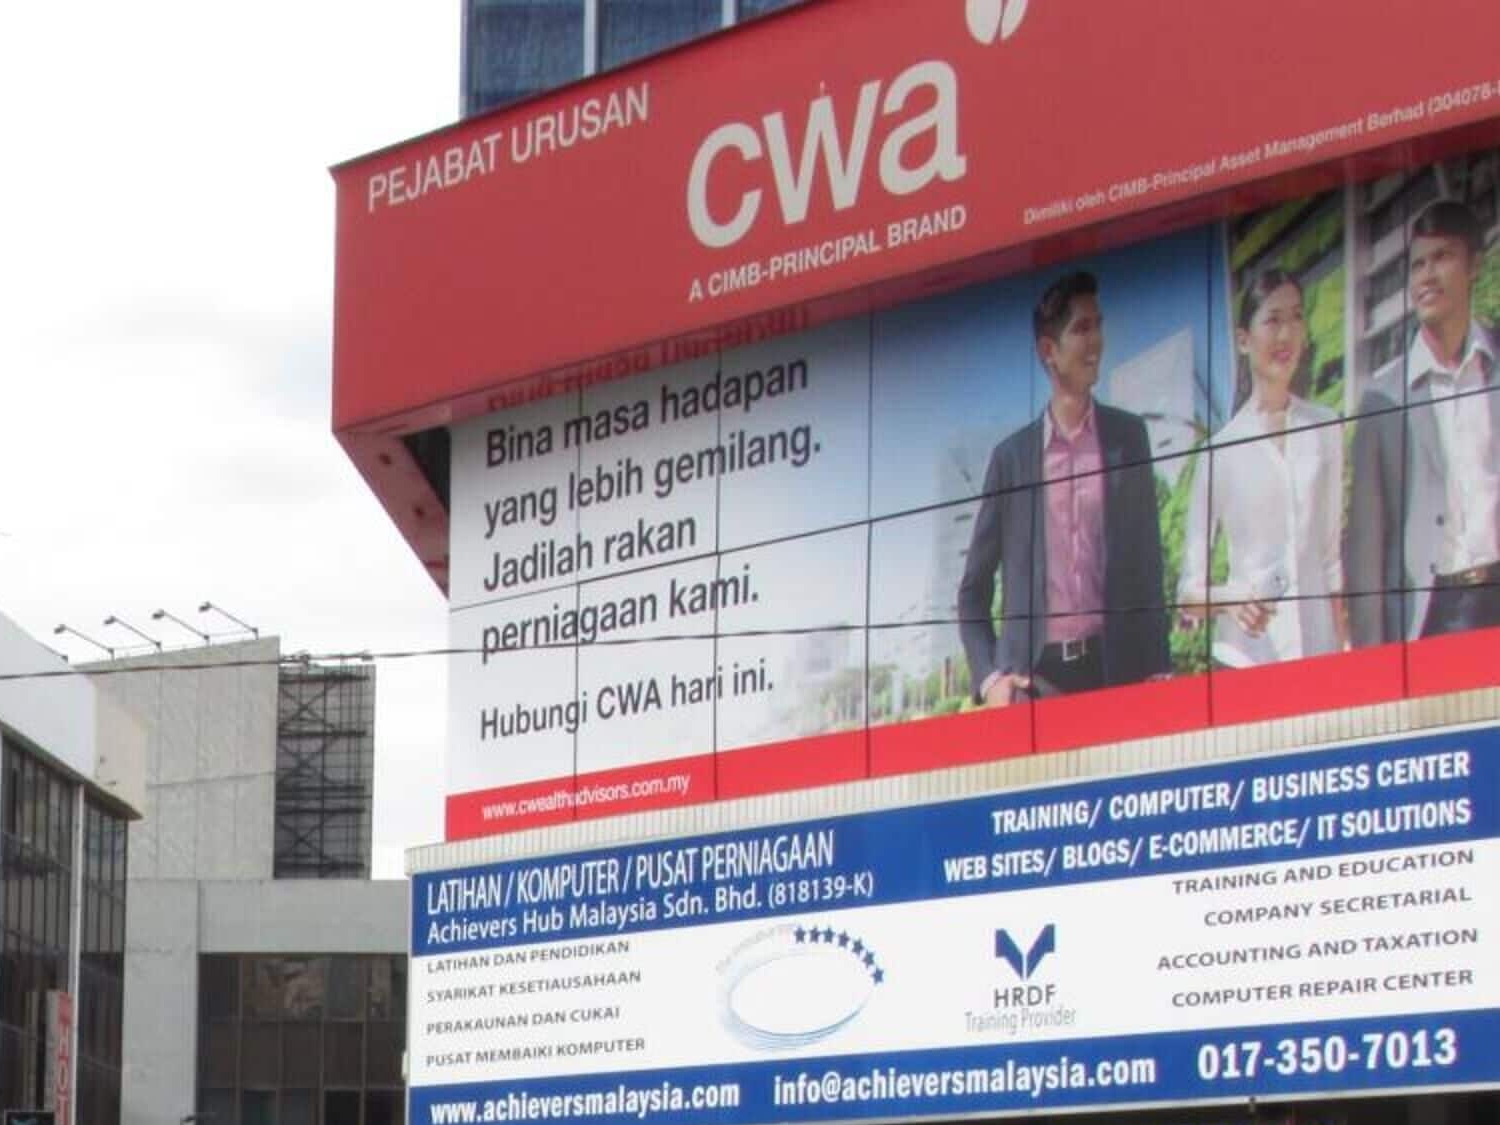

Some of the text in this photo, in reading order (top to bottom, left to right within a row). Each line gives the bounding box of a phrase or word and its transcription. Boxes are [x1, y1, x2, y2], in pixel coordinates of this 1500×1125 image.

[367, 82, 651, 212] PEJABAT URUSAN
[1108, 160, 1216, 202] CIMB-Principal
[1219, 146, 1261, 172] Asset
[1264, 117, 1364, 160] Management
[1366, 101, 1425, 131] Berhad
[689, 205, 967, 302] A CIMB-PRINCIPAL BRAND
[486, 426, 553, 469] Bina
[563, 398, 649, 450] masa
[660, 357, 809, 424] hadapan
[484, 423, 821, 538] yang lebih gemilang.
[483, 515, 697, 592] Jadilah rakan
[482, 564, 759, 664] perniagaan kami.
[480, 657, 774, 741] Hubungi CWA hari ini.
[1252, 763, 1371, 804] BUSINESS
[1376, 750, 1470, 787] CENTER
[427, 869, 501, 916] LATIHAN
[516, 853, 620, 905] KOMPUTER
[635, 843, 697, 890] PUSAT
[702, 830, 834, 885] PERNIAGAAN
[944, 857, 987, 884] WEB
[1316, 813, 1336, 842] IT
[1340, 797, 1472, 838] SOLUTIONS
[1172, 849, 1474, 896] TRAINING AND EDUCATION
[427, 870, 874, 946] Achievers Hub Malaysia Sdn. Bhd. (818139-K)
[1203, 887, 1472, 928] COMPANY SECRETARIAL
[427, 940, 631, 975] LATIHAN DAN PENDIDIKAN
[427, 970, 642, 1004] SYARIKAT KESETIAUSAHAAN
[1157, 927, 1478, 971] ACCOUNTING AND TAXATION
[426, 1006, 621, 1036] PERAKAUNAN DAN CUKAI
[964, 1007, 1077, 1034] Training Provider
[993, 984, 1057, 1009] HRDF
[1172, 968, 1474, 1009] COMPUTER REPAIR CENTER
[426, 1036, 645, 1068] PUSAT MEMBAIKI KOMPUTER
[431, 1028, 1458, 1125] www.achieversmalaysia.com info@achieversmalaysia.com 017-350-7013
